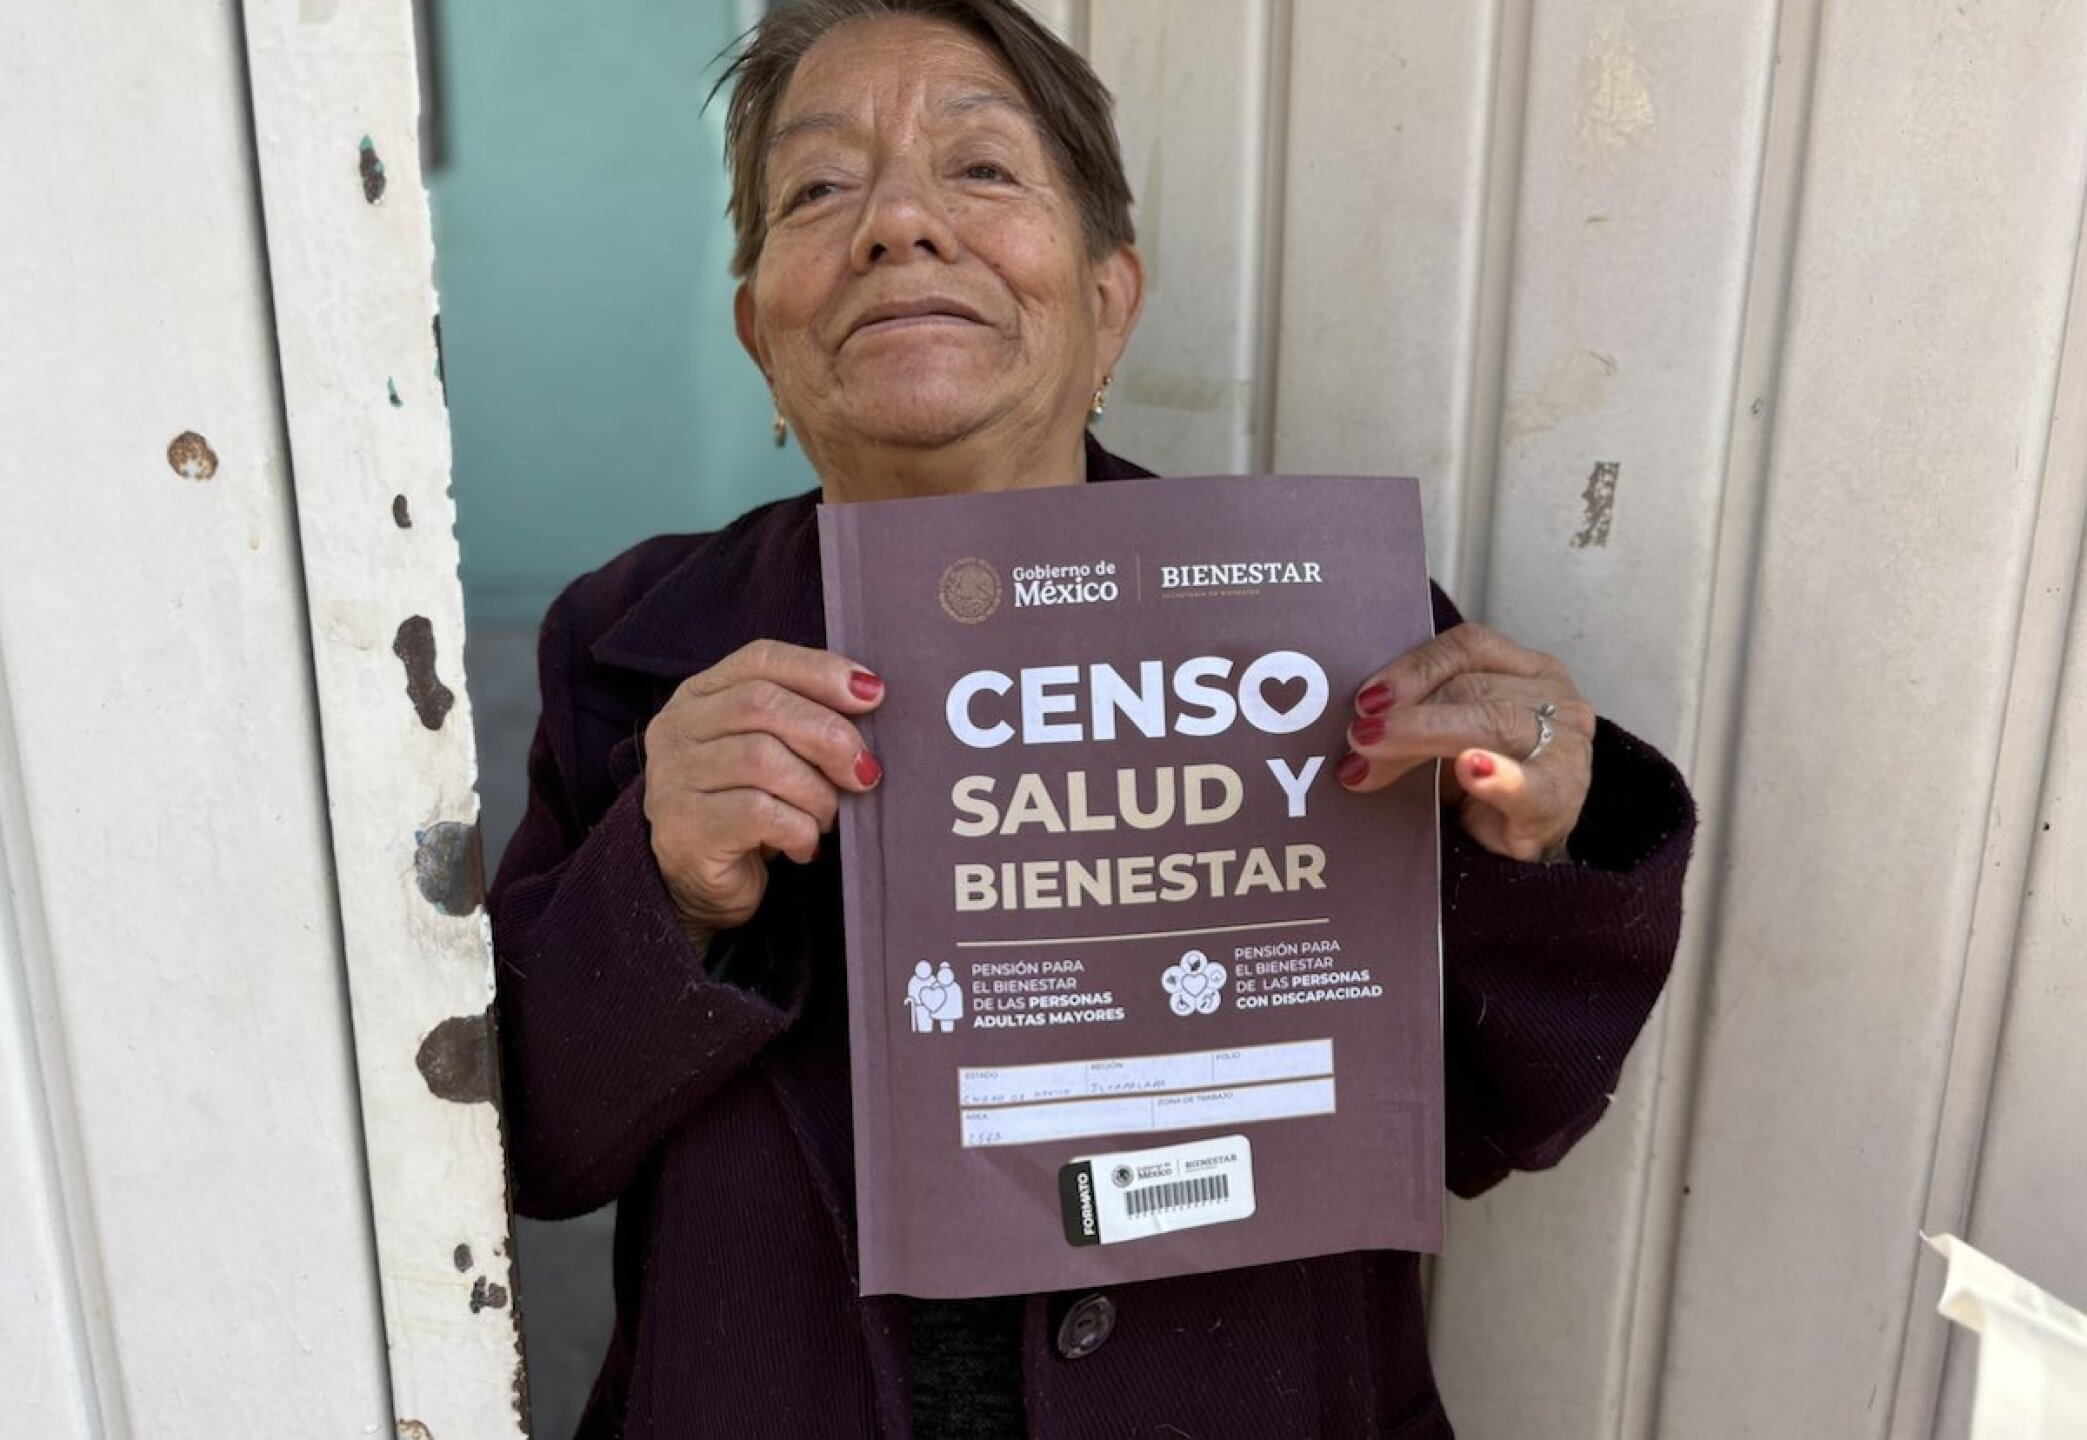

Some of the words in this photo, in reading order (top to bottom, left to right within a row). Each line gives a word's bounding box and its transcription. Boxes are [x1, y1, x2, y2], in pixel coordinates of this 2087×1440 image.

[1013, 564, 1090, 581] Gobierno
[1094, 561, 1116, 576] de
[1161, 562, 1322, 588] BIENESTAR
[1014, 577, 1119, 607] México
[945, 650, 1330, 748] CENSO
[951, 763, 1244, 837] SALUD
[1266, 755, 1326, 818] Y
[954, 844, 1327, 912] BIENESTAR
[1234, 941, 1298, 960] PENSIÓN
[1301, 940, 1341, 953] PARA
[971, 960, 1038, 977] PENSIÓN
[1042, 960, 1085, 973] PARA
[1235, 964, 1252, 976] EL
[1255, 956, 1333, 974] BIENESTAR
[972, 980, 990, 993] EL
[993, 977, 1077, 993] BIENESTAR
[1236, 979, 1255, 993] DE
[1263, 977, 1289, 990] LAS
[1292, 969, 1370, 987] PERSONAS
[973, 998, 993, 1011] DE
[998, 997, 1025, 1010] LAS
[1029, 991, 1113, 1008] PERSONAS
[1236, 995, 1268, 1009] CON
[1272, 985, 1383, 1006] DISCAPACIDAD
[974, 1012, 1046, 1028] ADULTAS
[1050, 1007, 1125, 1025] MAYORES
[1214, 1051, 1241, 1061] FOLIO
[1077, 1171, 1097, 1236] FORMATO
